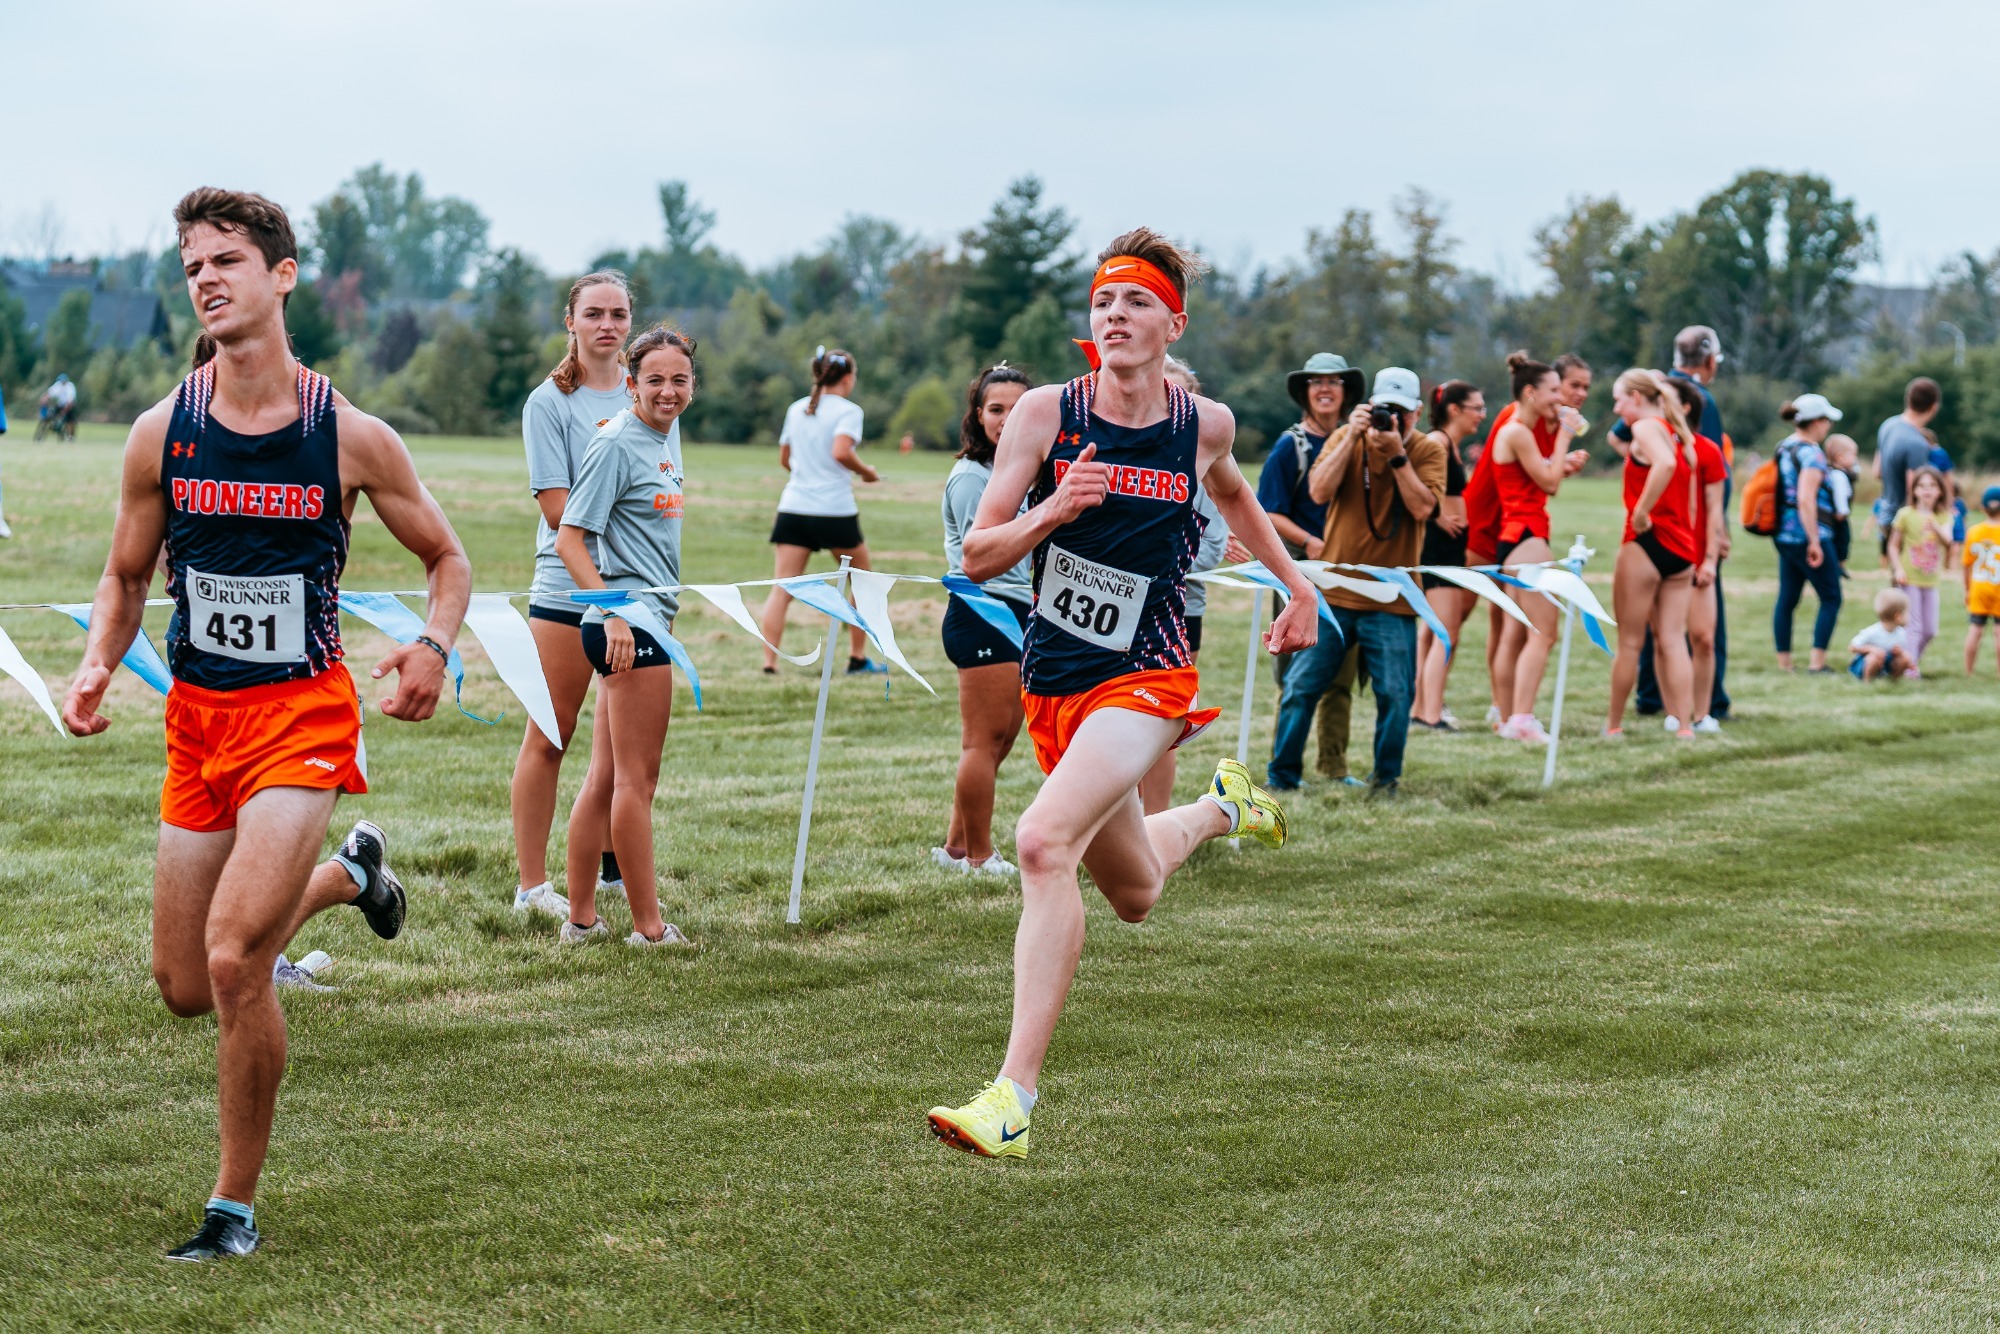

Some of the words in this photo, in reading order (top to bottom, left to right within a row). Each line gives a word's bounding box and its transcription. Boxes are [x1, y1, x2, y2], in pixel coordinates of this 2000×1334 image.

[172, 477, 325, 520] PIONEERS
[1055, 459, 1189, 503] PNEERS
[224, 579, 291, 591] WISCONSIN
[1073, 570, 1135, 600] RUNNER
[1081, 561, 1138, 587] WISCONSIN
[219, 590, 292, 605] RUNNER
[1053, 586, 1120, 637] 430
[206, 611, 277, 652] 431
